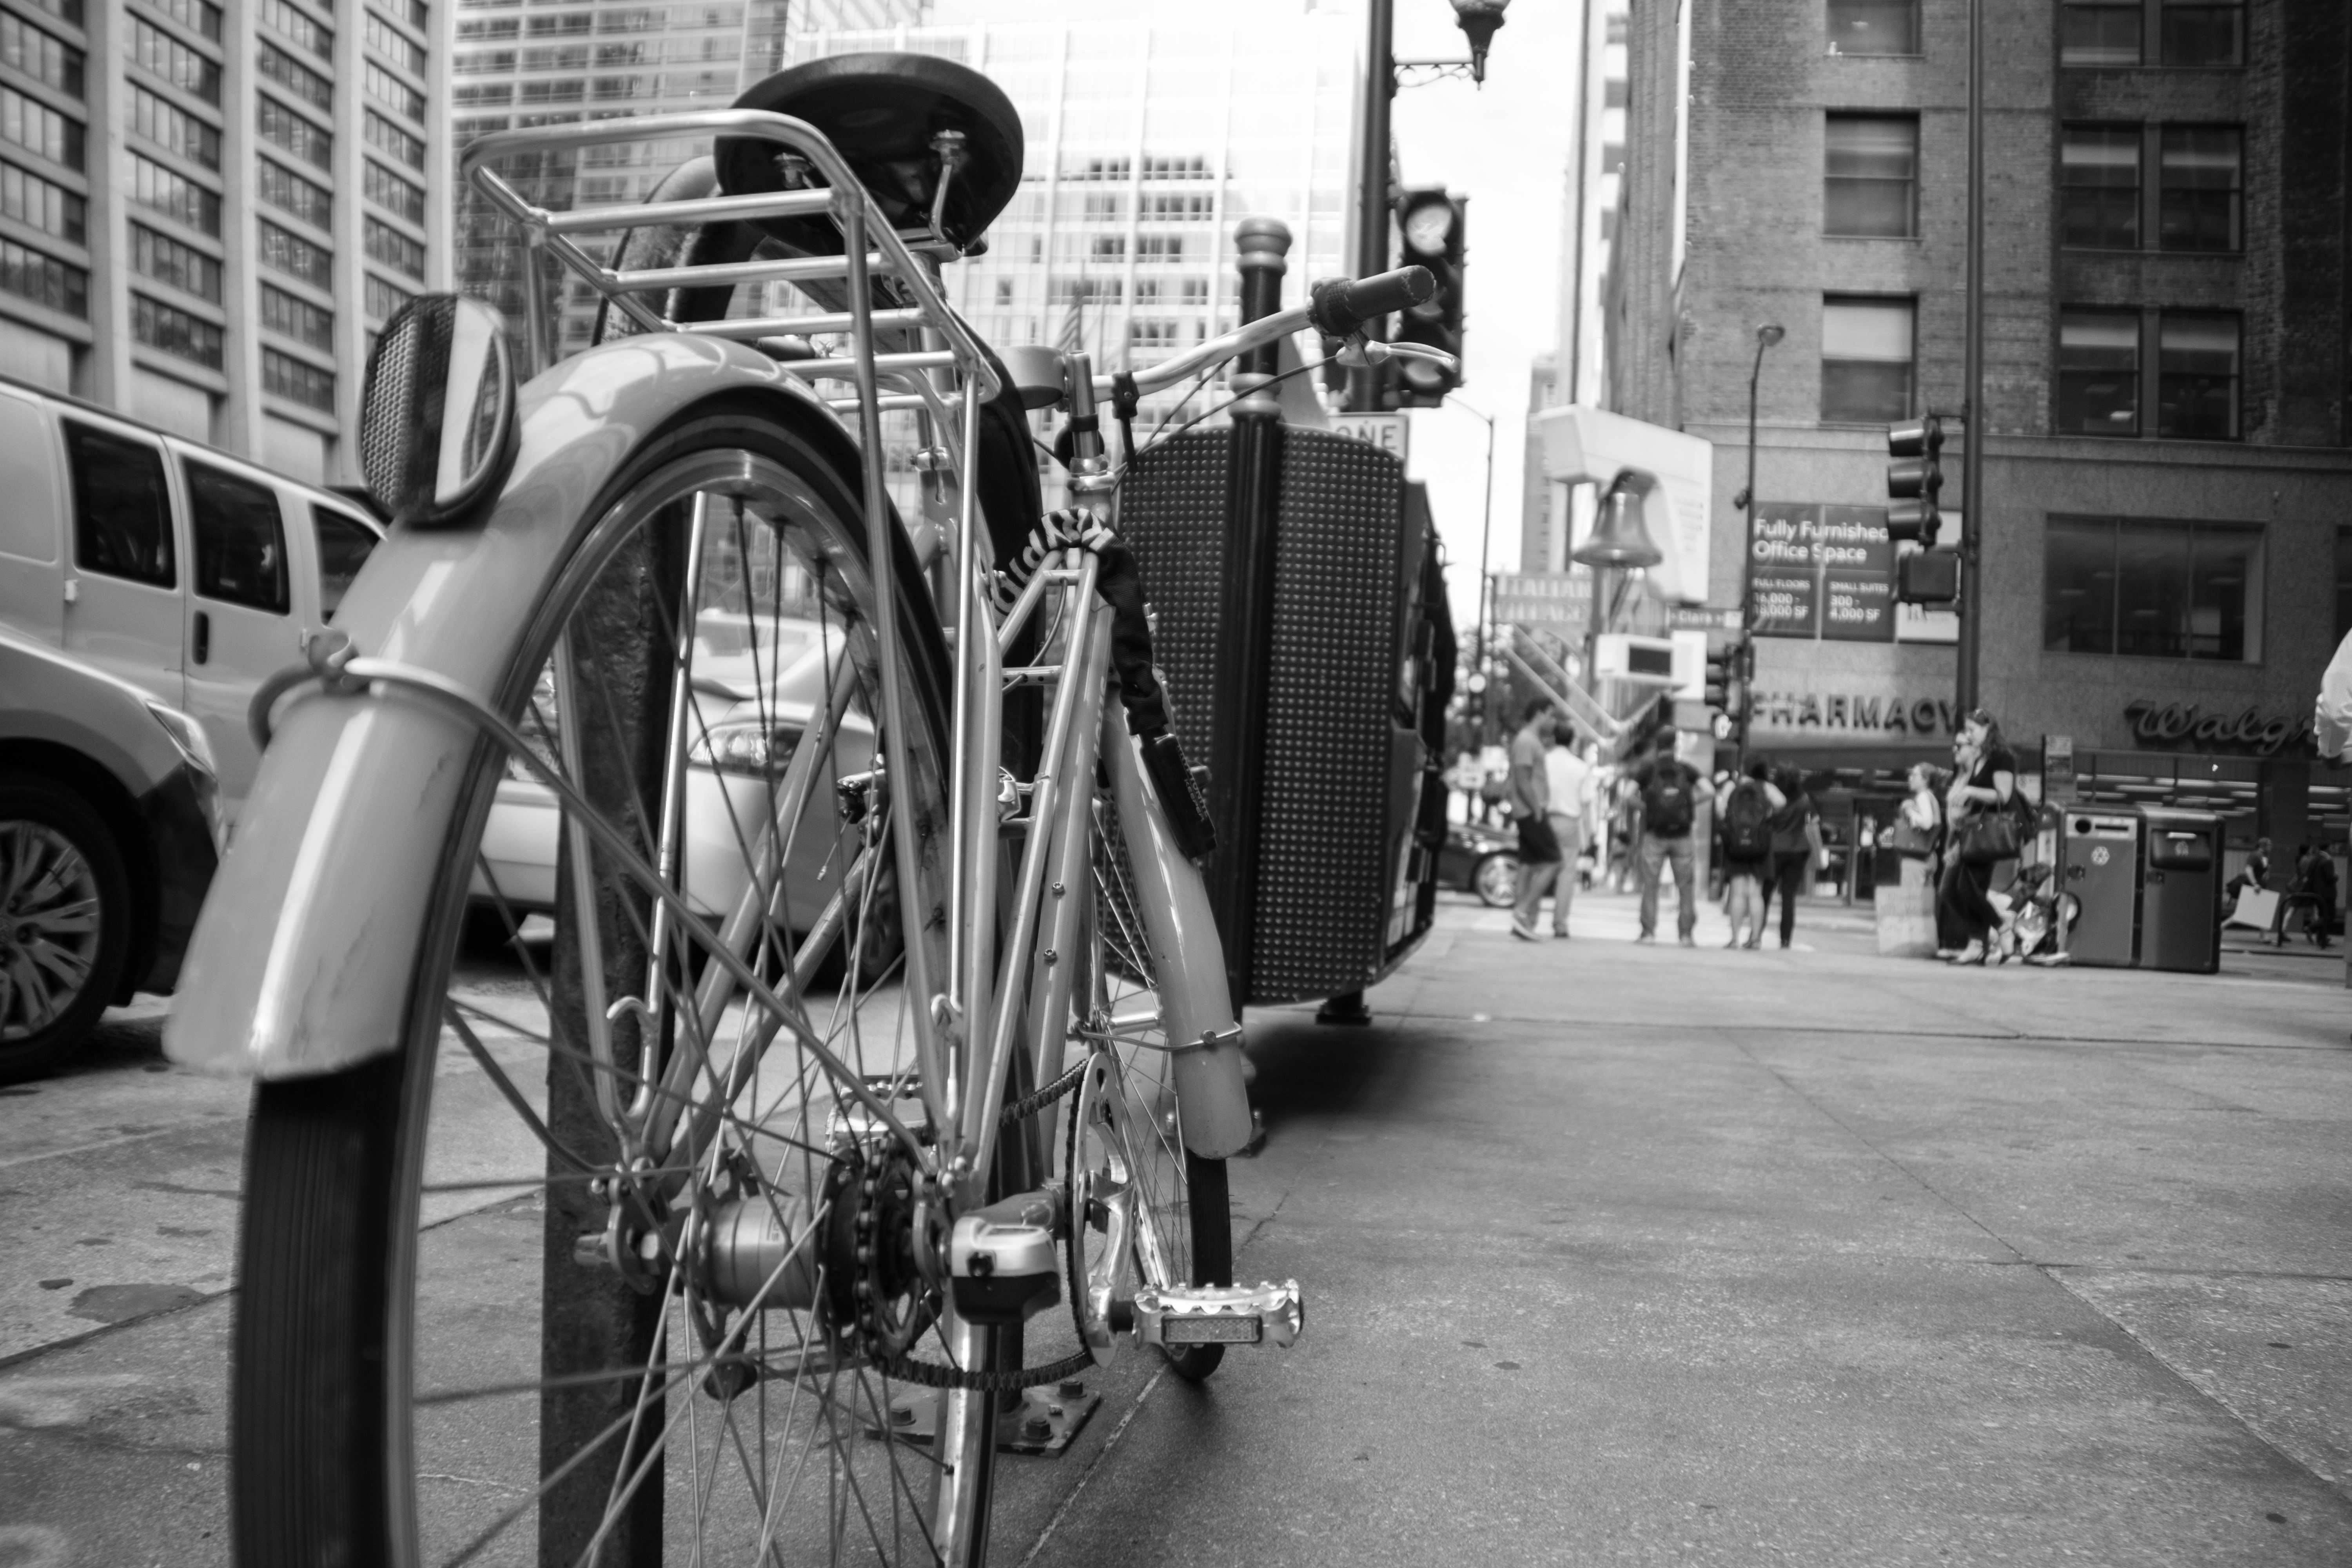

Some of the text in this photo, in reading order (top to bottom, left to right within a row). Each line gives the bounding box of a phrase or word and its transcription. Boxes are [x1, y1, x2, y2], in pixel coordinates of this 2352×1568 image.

[1753, 518, 1797, 542] Fully
[1752, 540, 1867, 564] Office Space
[1753, 577, 1810, 592] FULL FLOORS
[1829, 581, 1889, 594] SMALL SUITES
[1830, 594, 1853, 608] 300
[1679, 610, 1713, 624] Clark
[1794, 605, 1809, 619] SF
[1829, 607, 1881, 622] 4,000 SF
[1751, 691, 1958, 733] PHARMACY
